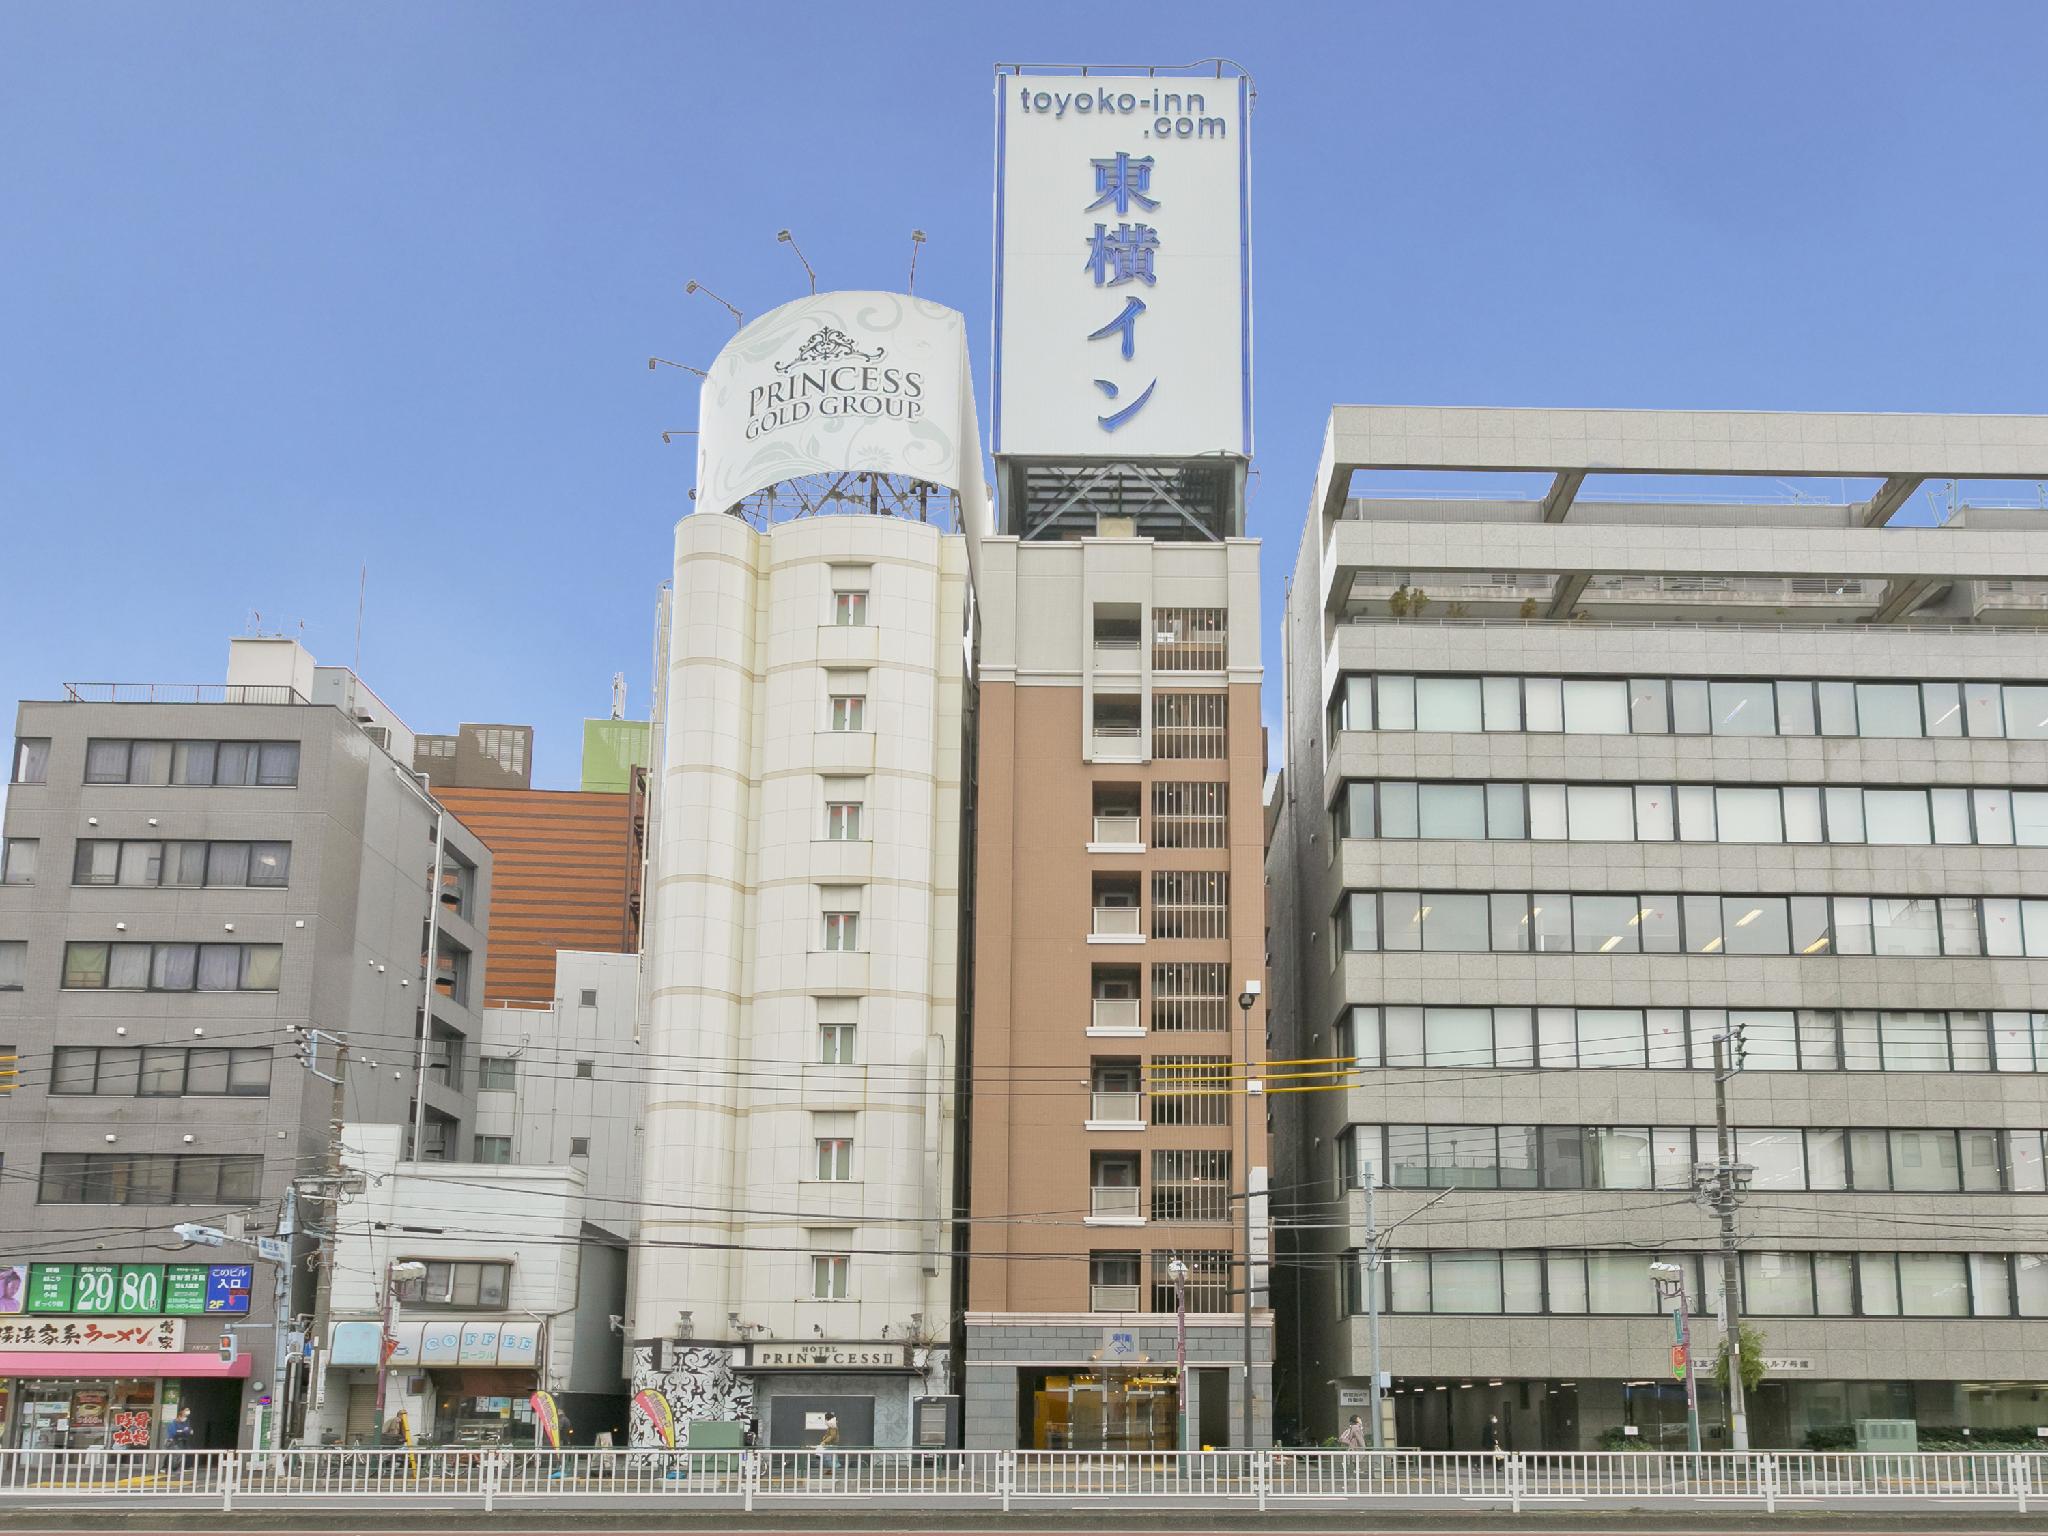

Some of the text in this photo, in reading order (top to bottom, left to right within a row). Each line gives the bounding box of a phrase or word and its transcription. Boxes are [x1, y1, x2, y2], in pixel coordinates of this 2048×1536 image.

[1020, 87, 1206, 119] toyoko-inn
[1143, 115, 1227, 138] .com
[1084, 151, 1161, 433] 東横イン
[749, 366, 922, 417] PRINCESS
[745, 396, 922, 440] GOLD GROUP
[212, 1268, 247, 1277] このビル
[217, 1278, 241, 1289] 入口
[209, 1300, 225, 1309] 2F
[425, 1332, 532, 1350] COFFEE
